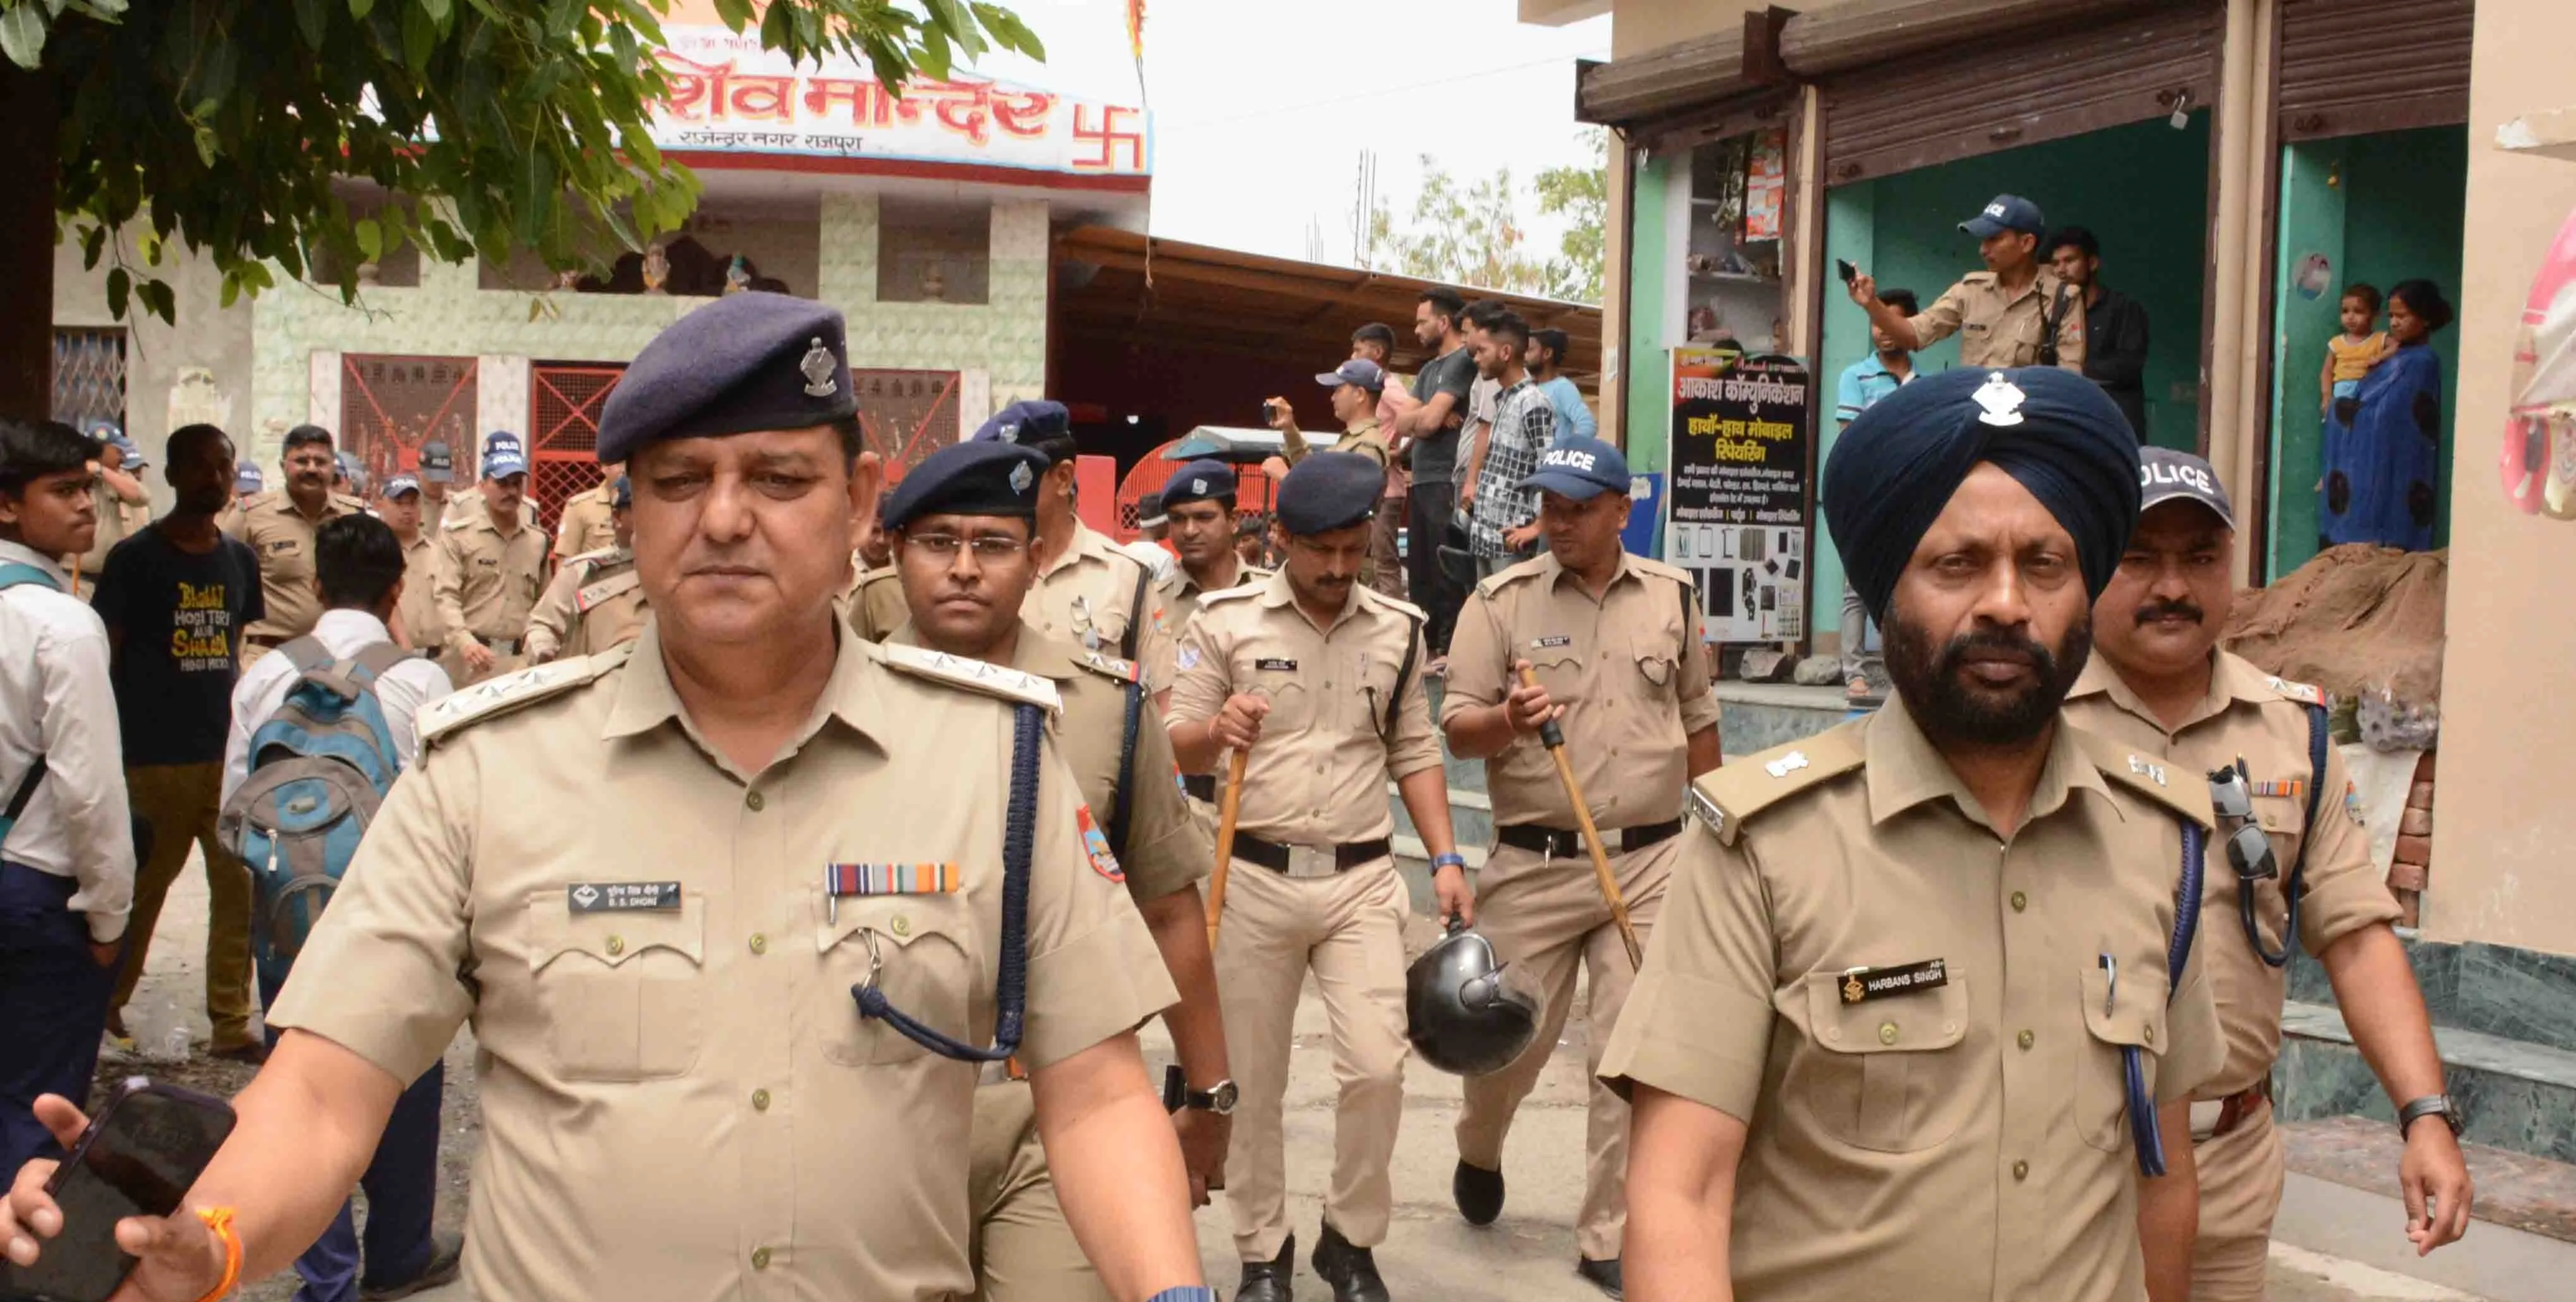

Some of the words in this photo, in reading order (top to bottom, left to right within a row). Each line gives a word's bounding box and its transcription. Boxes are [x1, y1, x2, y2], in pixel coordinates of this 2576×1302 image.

[752, 131, 798, 147] नगर
[805, 134, 864, 156] राजपुरा
[1679, 377, 1723, 400] आकाश
[1543, 449, 1596, 472] POLICE
[2141, 462, 2214, 495] OLICE
[1868, 974, 1911, 992] HARBANS
[1914, 968, 1943, 984] SINGH
